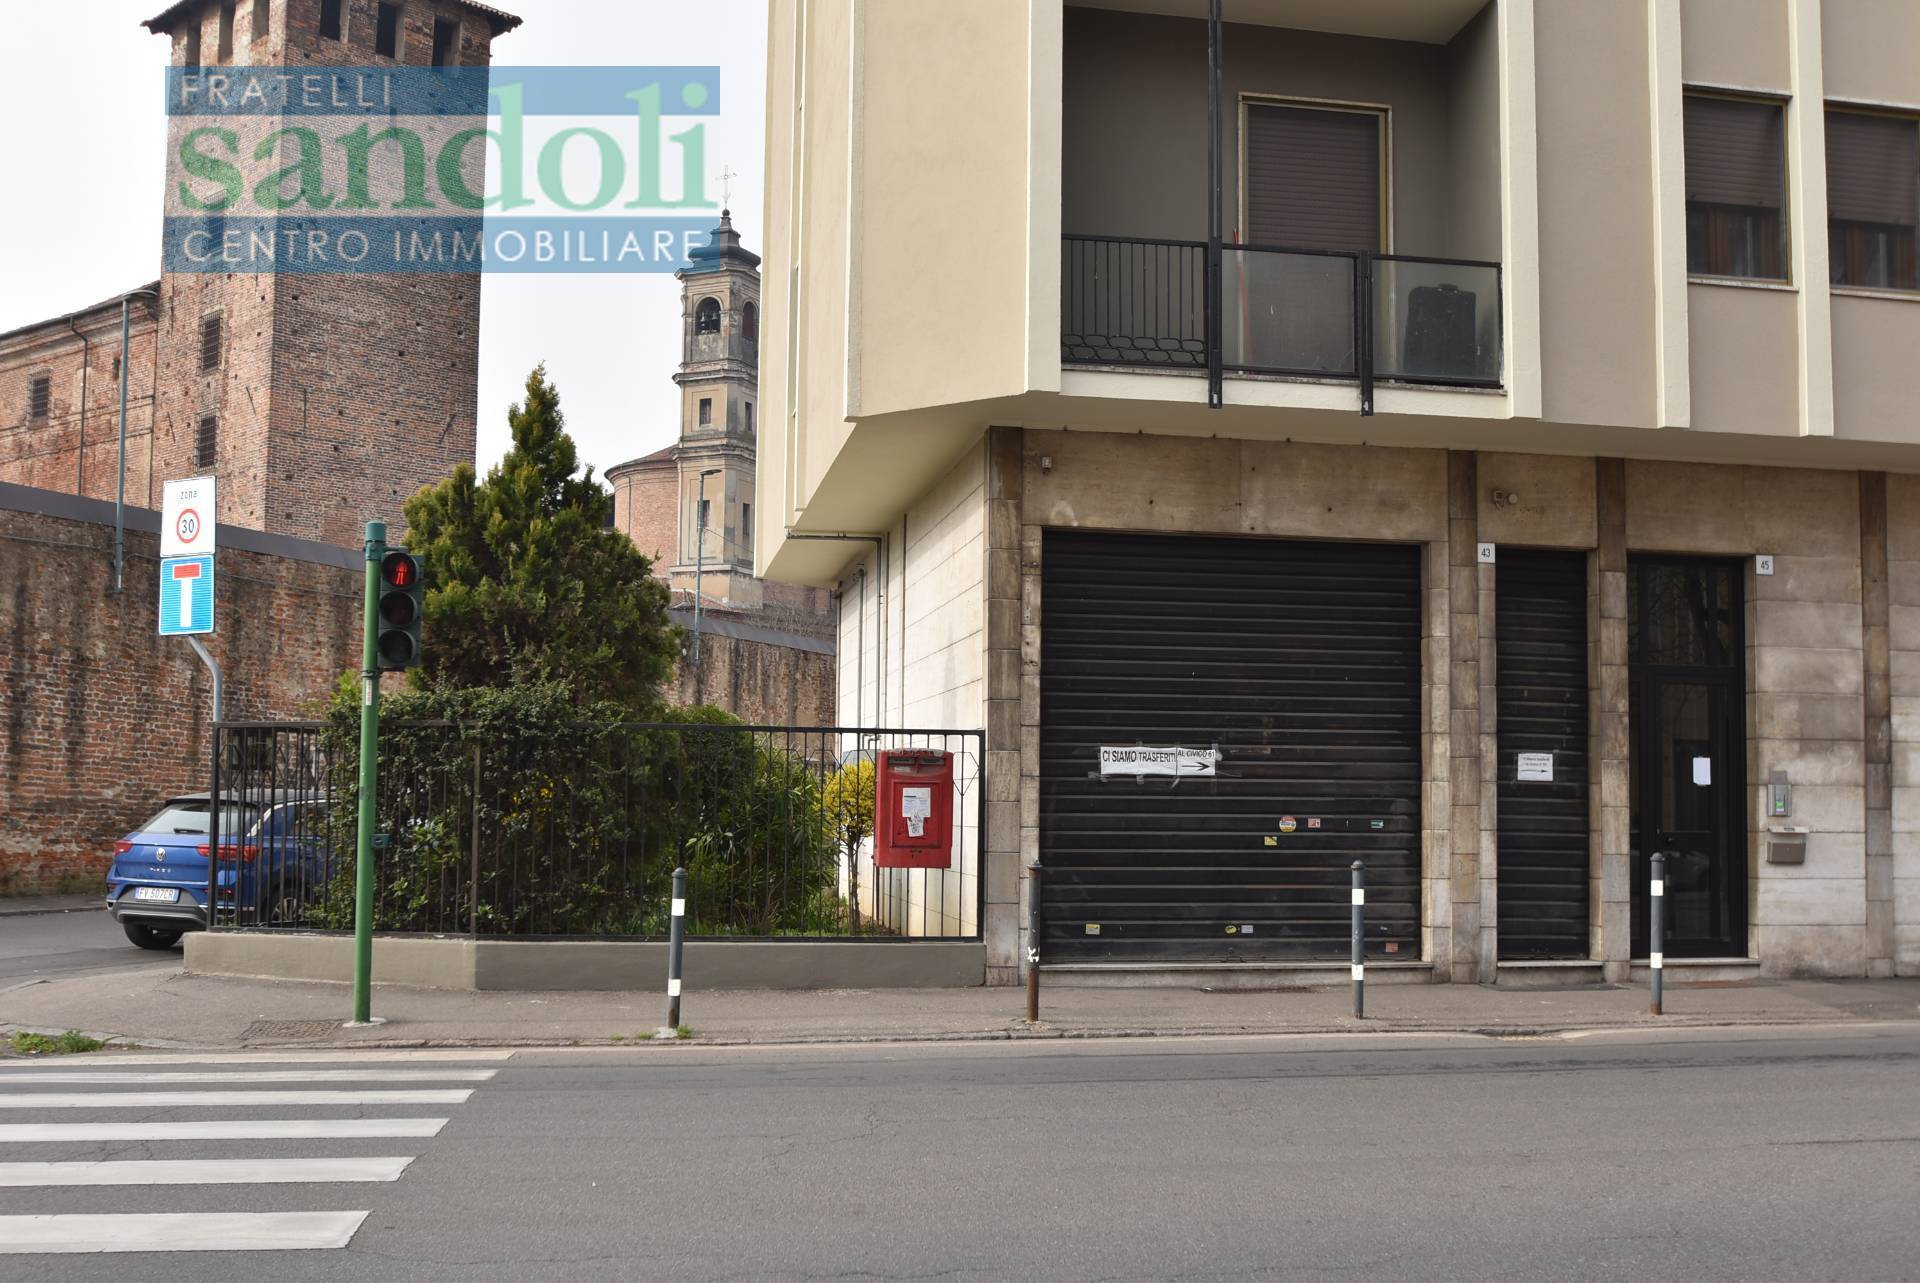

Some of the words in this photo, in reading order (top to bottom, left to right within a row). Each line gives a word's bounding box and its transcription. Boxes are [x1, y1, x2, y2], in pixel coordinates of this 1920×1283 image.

[182, 518, 195, 534] 30
[1481, 548, 1491, 558] 43
[1760, 560, 1770, 571] 45
[1102, 750, 1111, 762] CI
[1111, 750, 1137, 763] SIAMO
[1138, 752, 1176, 763] TRASFERITI
